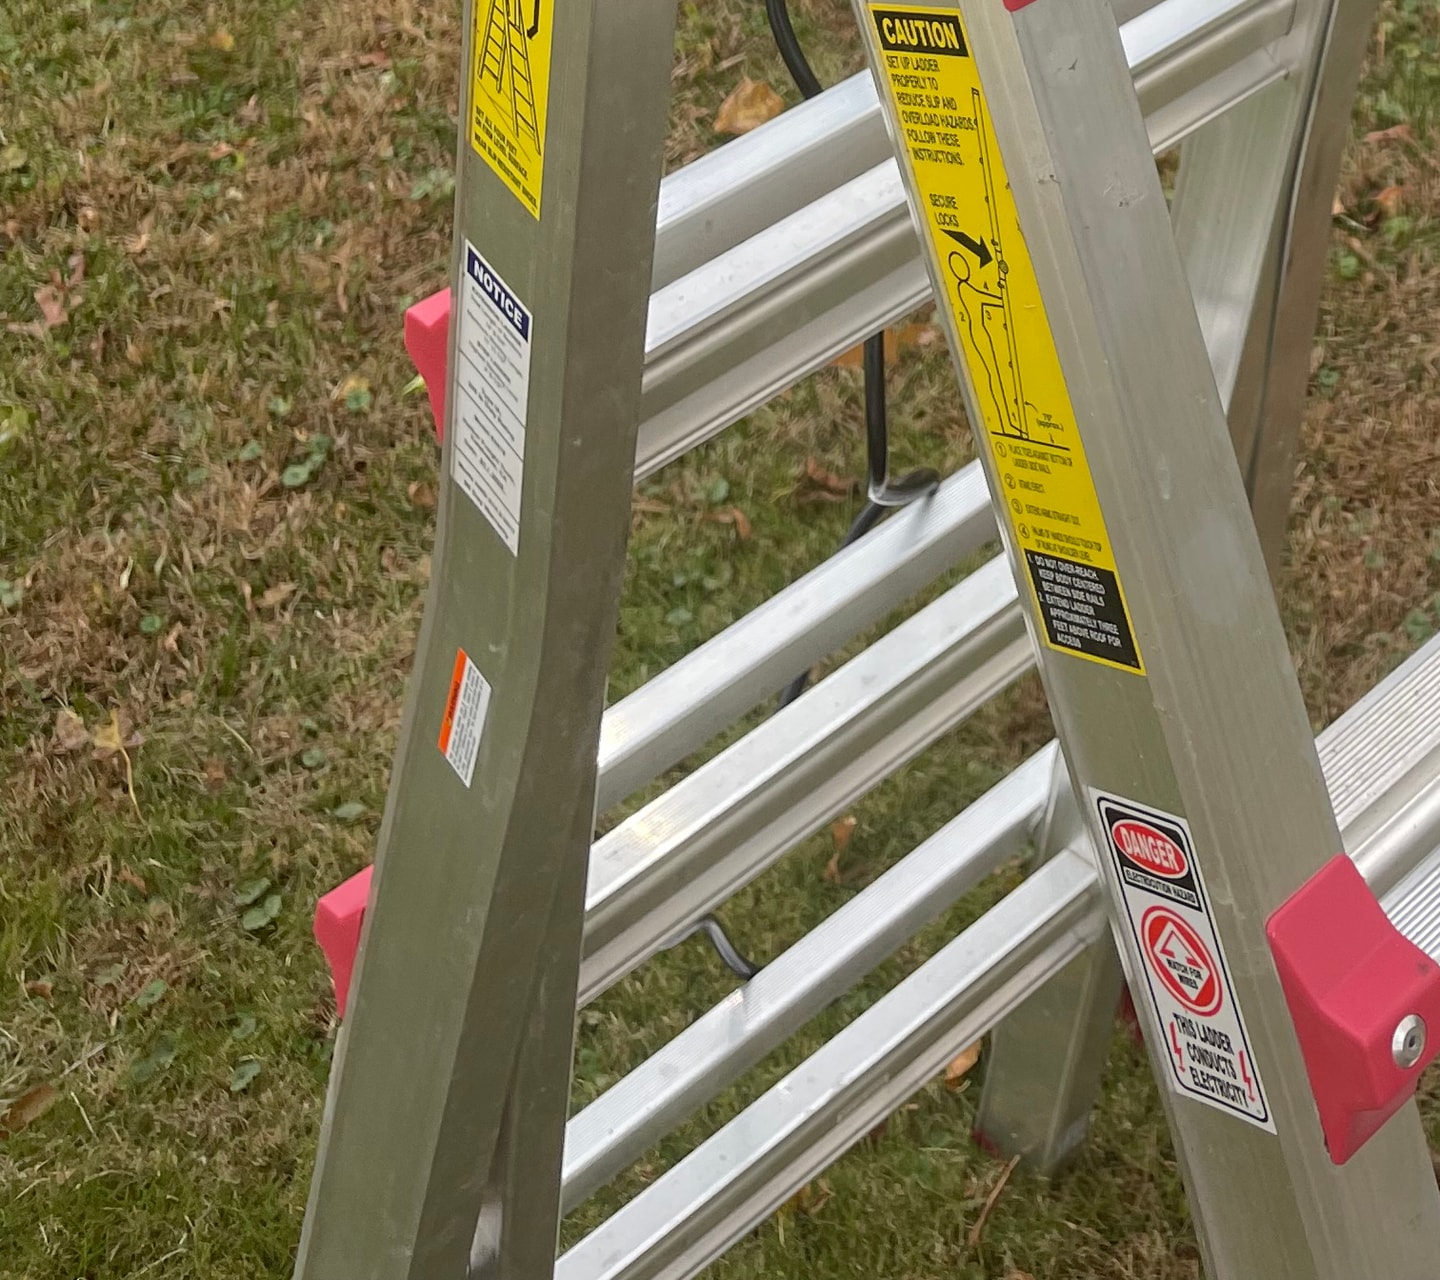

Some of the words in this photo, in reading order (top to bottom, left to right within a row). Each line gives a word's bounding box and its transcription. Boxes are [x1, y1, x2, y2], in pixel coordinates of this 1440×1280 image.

[882, 18, 960, 49] CAUTION
[887, 55, 899, 68] SET
[900, 57, 910, 69] UP
[911, 57, 940, 72] LADDER
[891, 73, 926, 89] PROPERLY
[927, 77, 938, 90] TO
[896, 92, 926, 108] REDUCE
[925, 93, 941, 109] SLIP
[942, 97, 957, 110] AND
[902, 110, 940, 126] OVERLOAD
[907, 128, 936, 143] FOLLOW
[936, 132, 960, 148] THESE
[929, 193, 958, 210] SECURE
[934, 212, 959, 227] LOCKS
[473, 259, 523, 330] NOTICE
[983, 281, 989, 291] 4
[959, 311, 966, 322] 2
[985, 310, 992, 320] 3
[1034, 555, 1045, 566] DO
[1045, 557, 1057, 569] NOT
[1038, 568, 1054, 581] KEEP
[1055, 572, 1071, 585] BODY
[1073, 577, 1105, 595] CENTERED
[1042, 580, 1071, 597] BETWEEN
[1046, 594, 1070, 609] EXTEND
[1070, 600, 1095, 616] LADDER
[1053, 619, 1068, 632] FEET
[1098, 619, 1119, 635] THREE
[1119, 826, 1180, 872] DANGER
[1126, 869, 1171, 895] ELECTROCUTION
[1172, 885, 1196, 904] HAZARD
[1166, 957, 1189, 975] WATCH
[1189, 966, 1203, 981] FOR
[1177, 972, 1199, 990] WIRES
[1172, 1012, 1197, 1040] THIS
[1195, 1021, 1234, 1056] LADDER
[1187, 1041, 1237, 1080] CONDUCTS
[1189, 1065, 1248, 1108] ELECTRICITY
